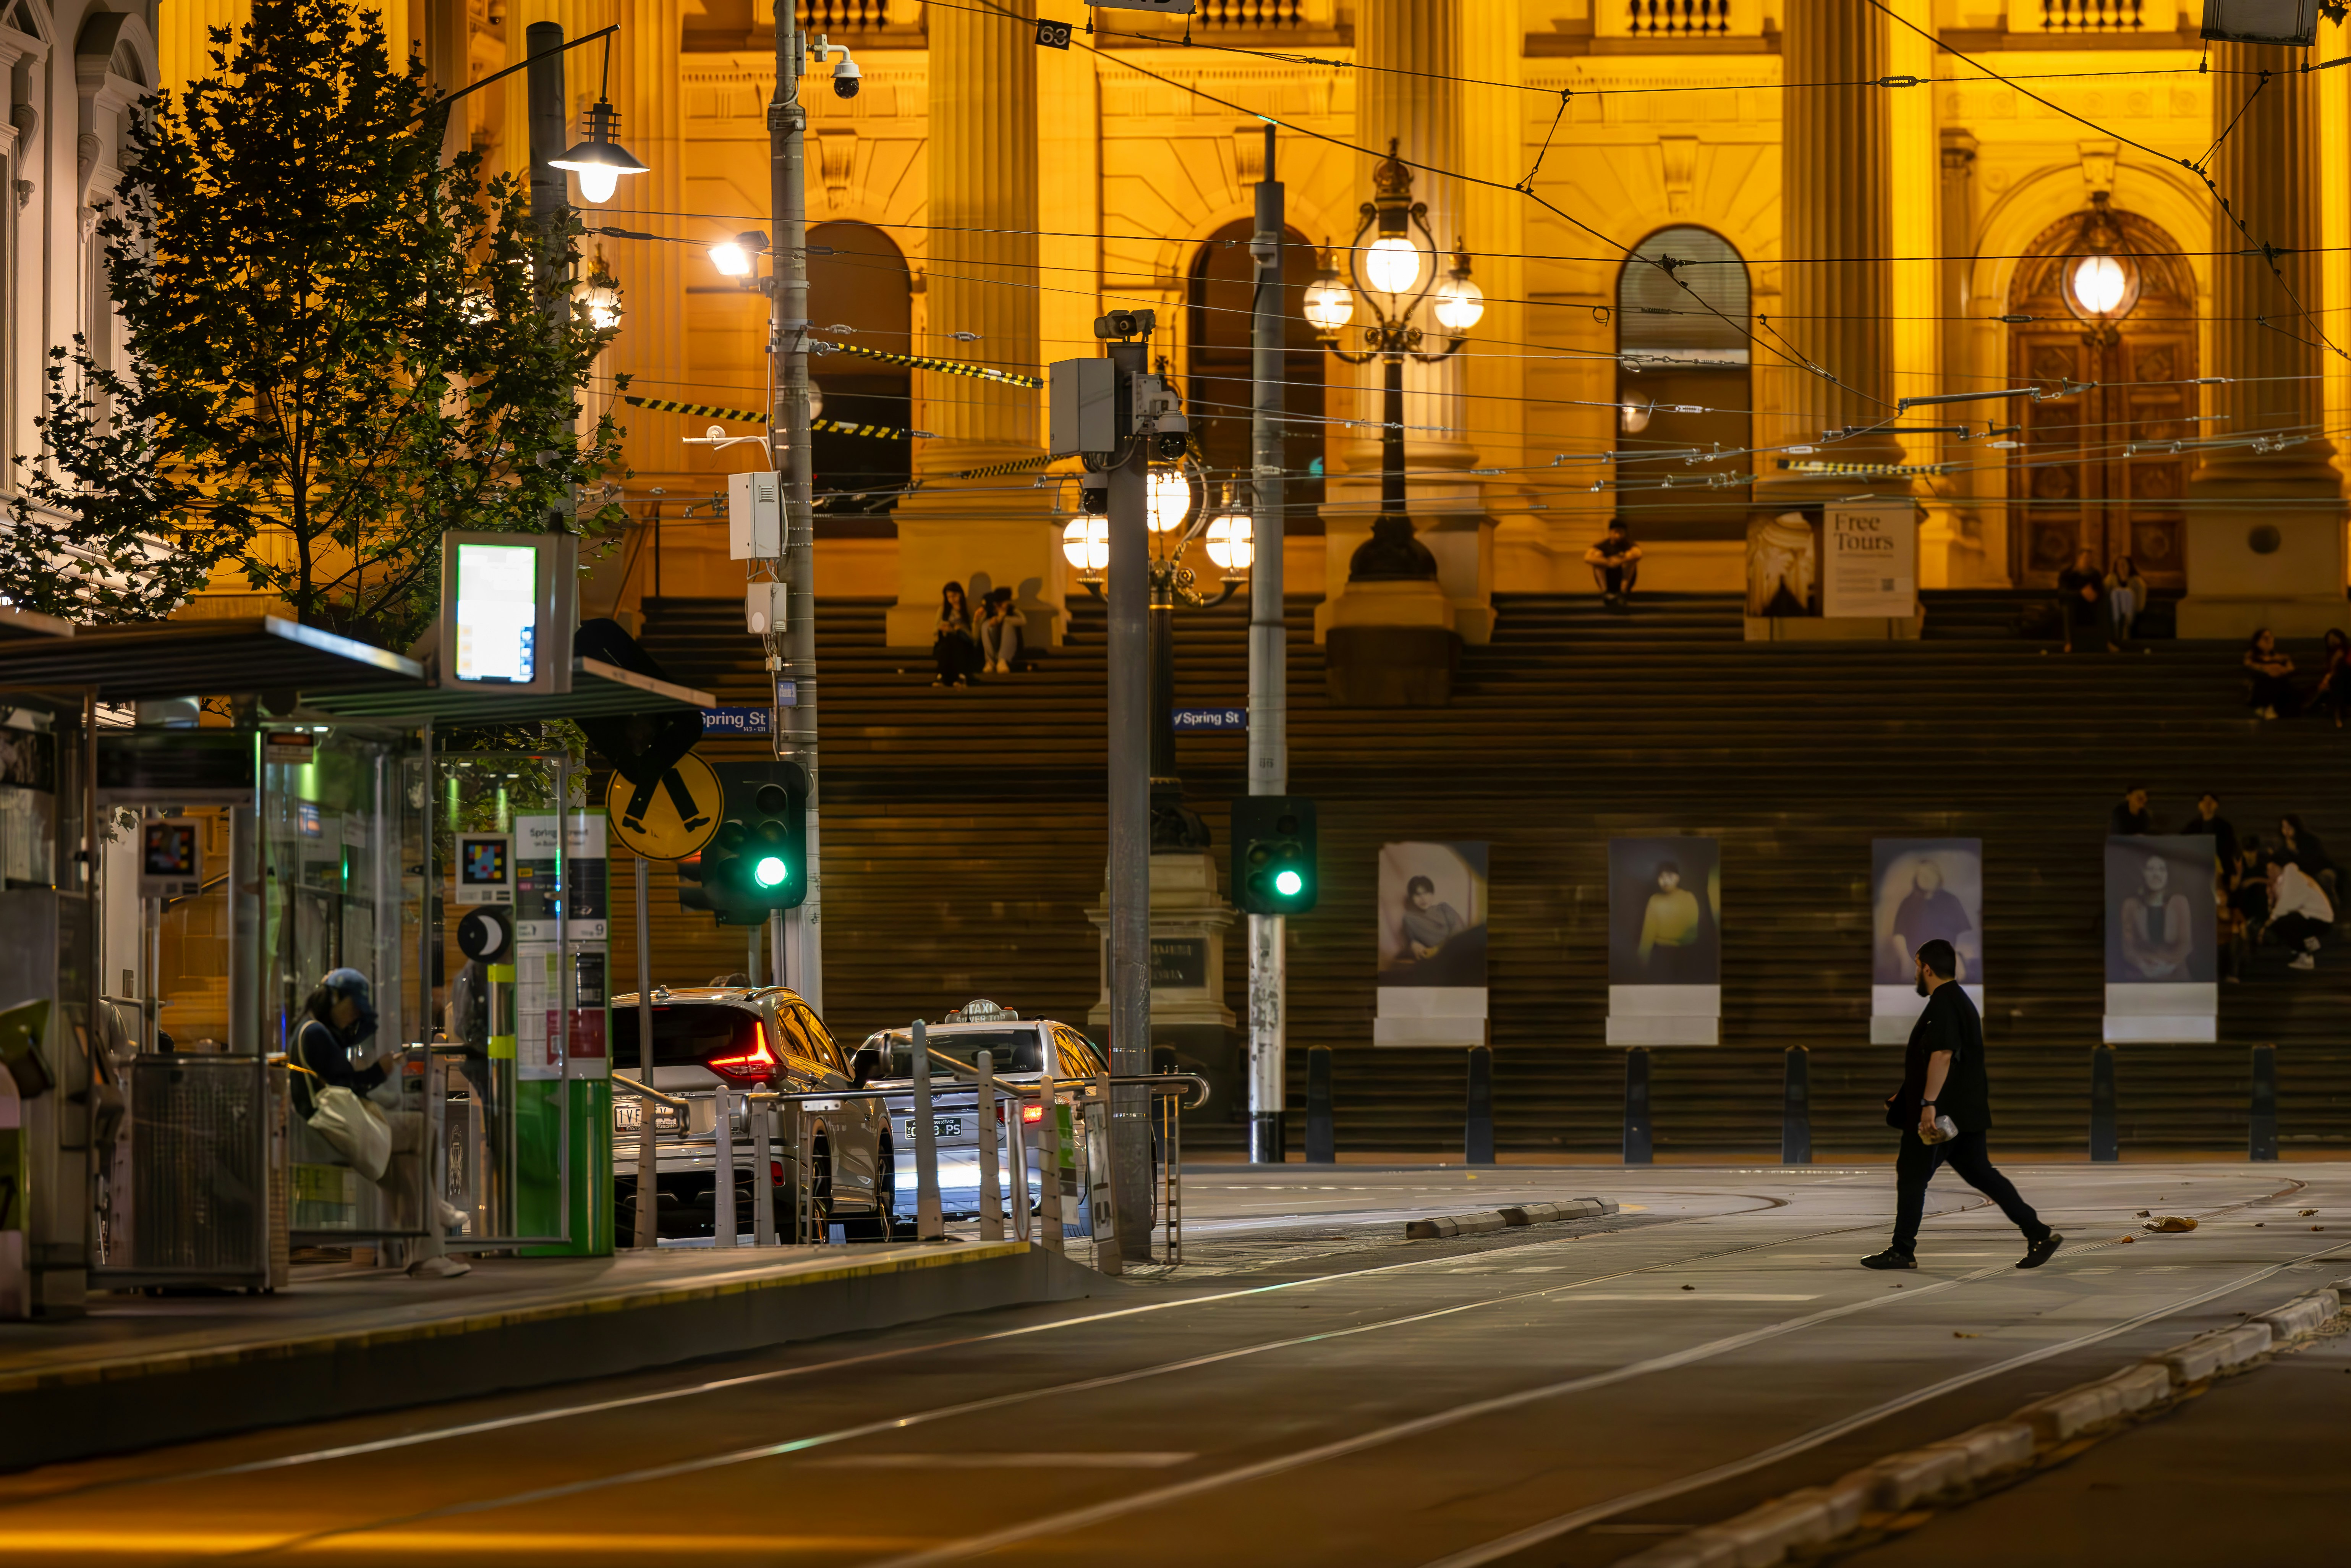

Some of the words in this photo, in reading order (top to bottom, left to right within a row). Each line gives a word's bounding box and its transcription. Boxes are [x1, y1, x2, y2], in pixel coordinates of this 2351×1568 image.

[1040, 26, 1067, 45] 63
[1834, 513, 1880, 531] Free
[1833, 532, 1894, 550] Tours
[750, 712, 766, 725] St
[1183, 711, 1222, 726] Spring
[1225, 711, 1239, 723] St
[968, 1003, 993, 1015] TAXI
[989, 1013, 1006, 1022] TOP
[946, 1124, 960, 1135] PS
